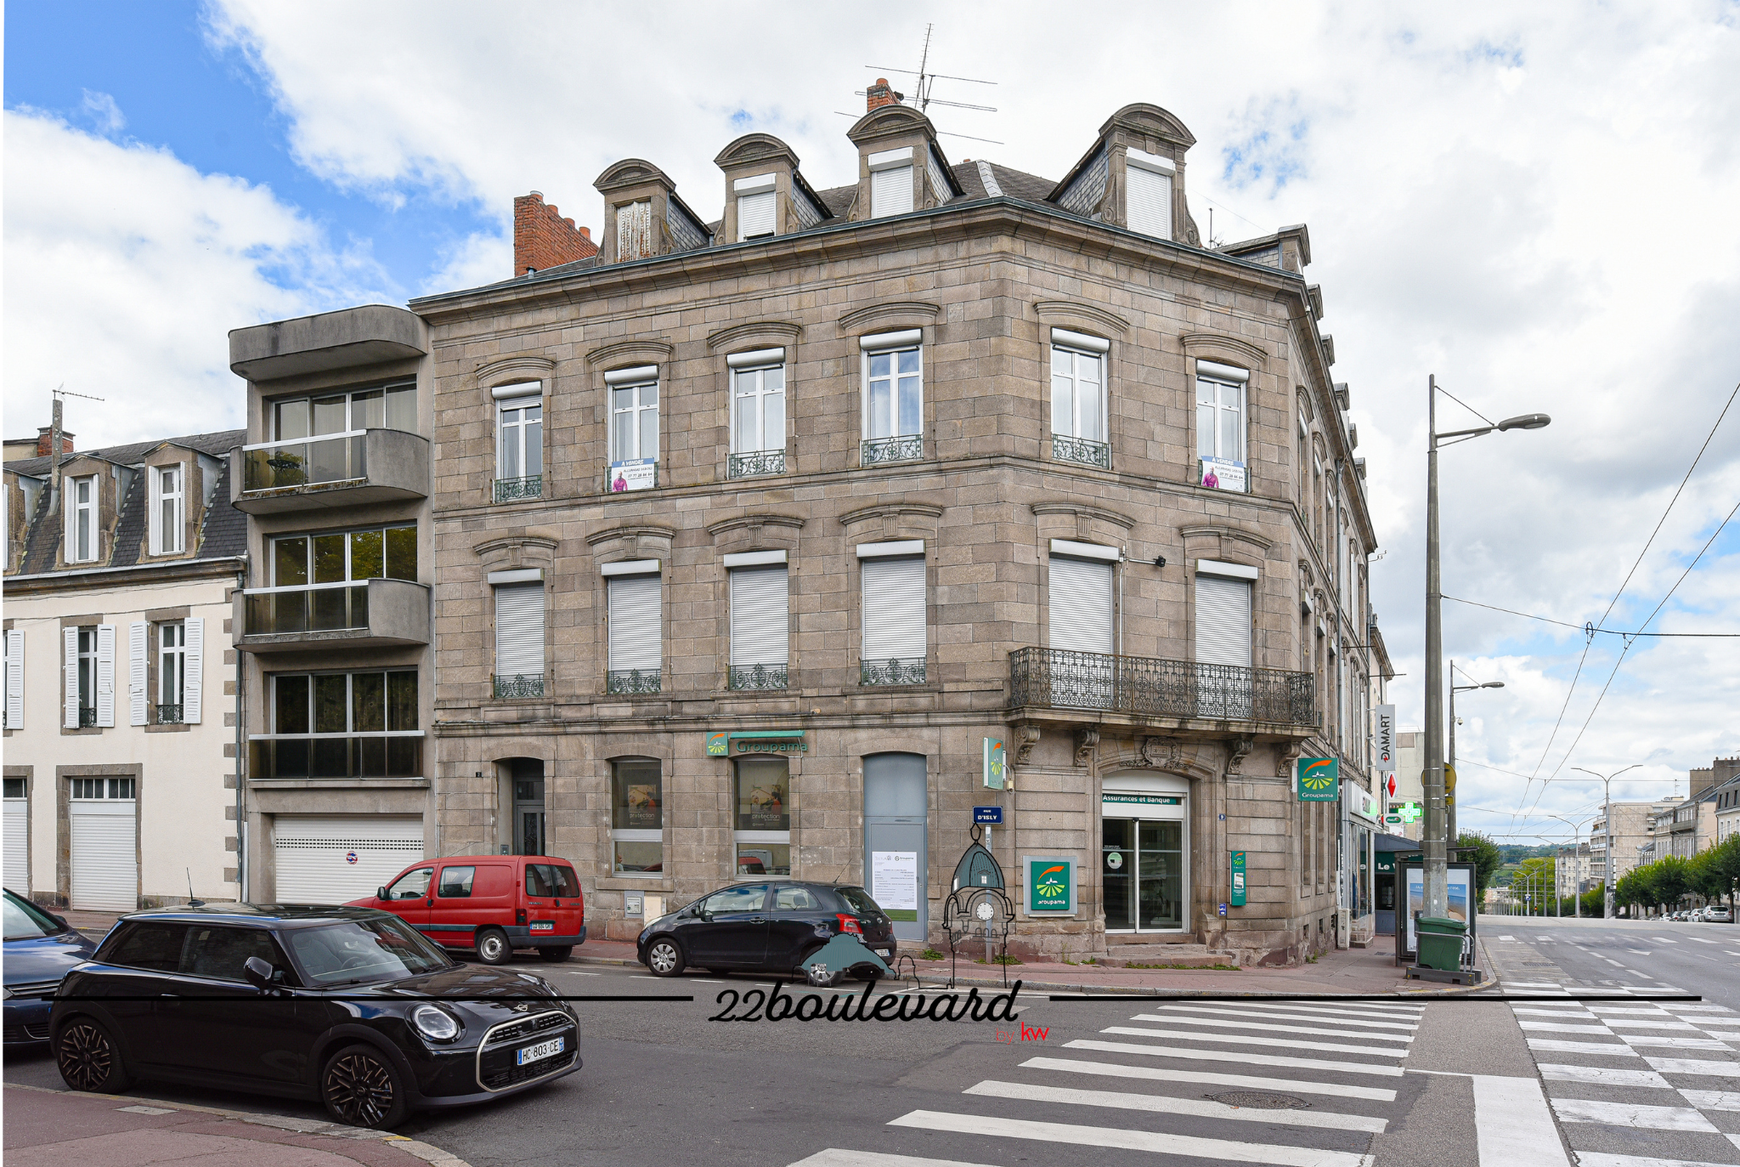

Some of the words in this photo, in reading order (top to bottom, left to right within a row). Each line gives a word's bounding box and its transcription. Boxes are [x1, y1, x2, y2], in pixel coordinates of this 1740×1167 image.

[1380, 714, 1390, 762] DAMART
[736, 740, 808, 753] Groupama
[1103, 794, 1138, 802] Assurances
[1378, 862, 1390, 870] Le
